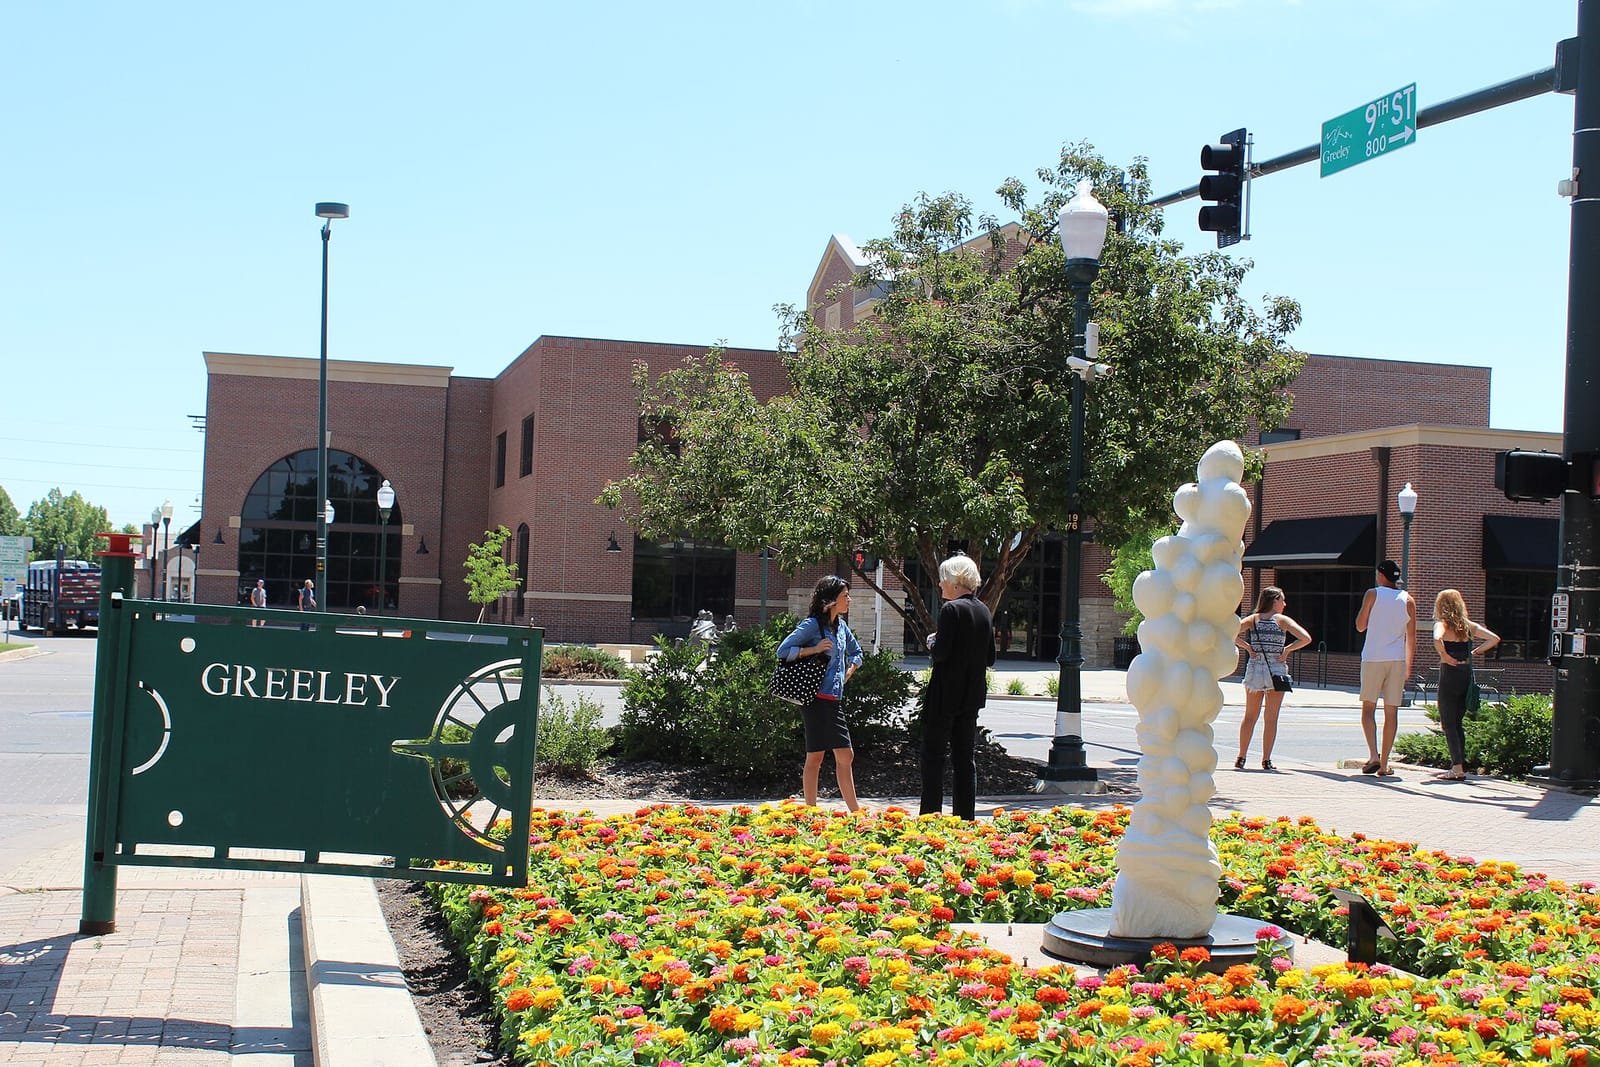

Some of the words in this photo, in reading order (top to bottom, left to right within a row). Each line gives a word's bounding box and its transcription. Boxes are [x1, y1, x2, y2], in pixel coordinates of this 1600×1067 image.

[1365, 97, 1389, 136] 9TH
[1391, 86, 1415, 125] ST
[1322, 145, 1350, 164] Greeley
[1365, 135, 1386, 157] 800
[201, 662, 402, 708] GREELEY
